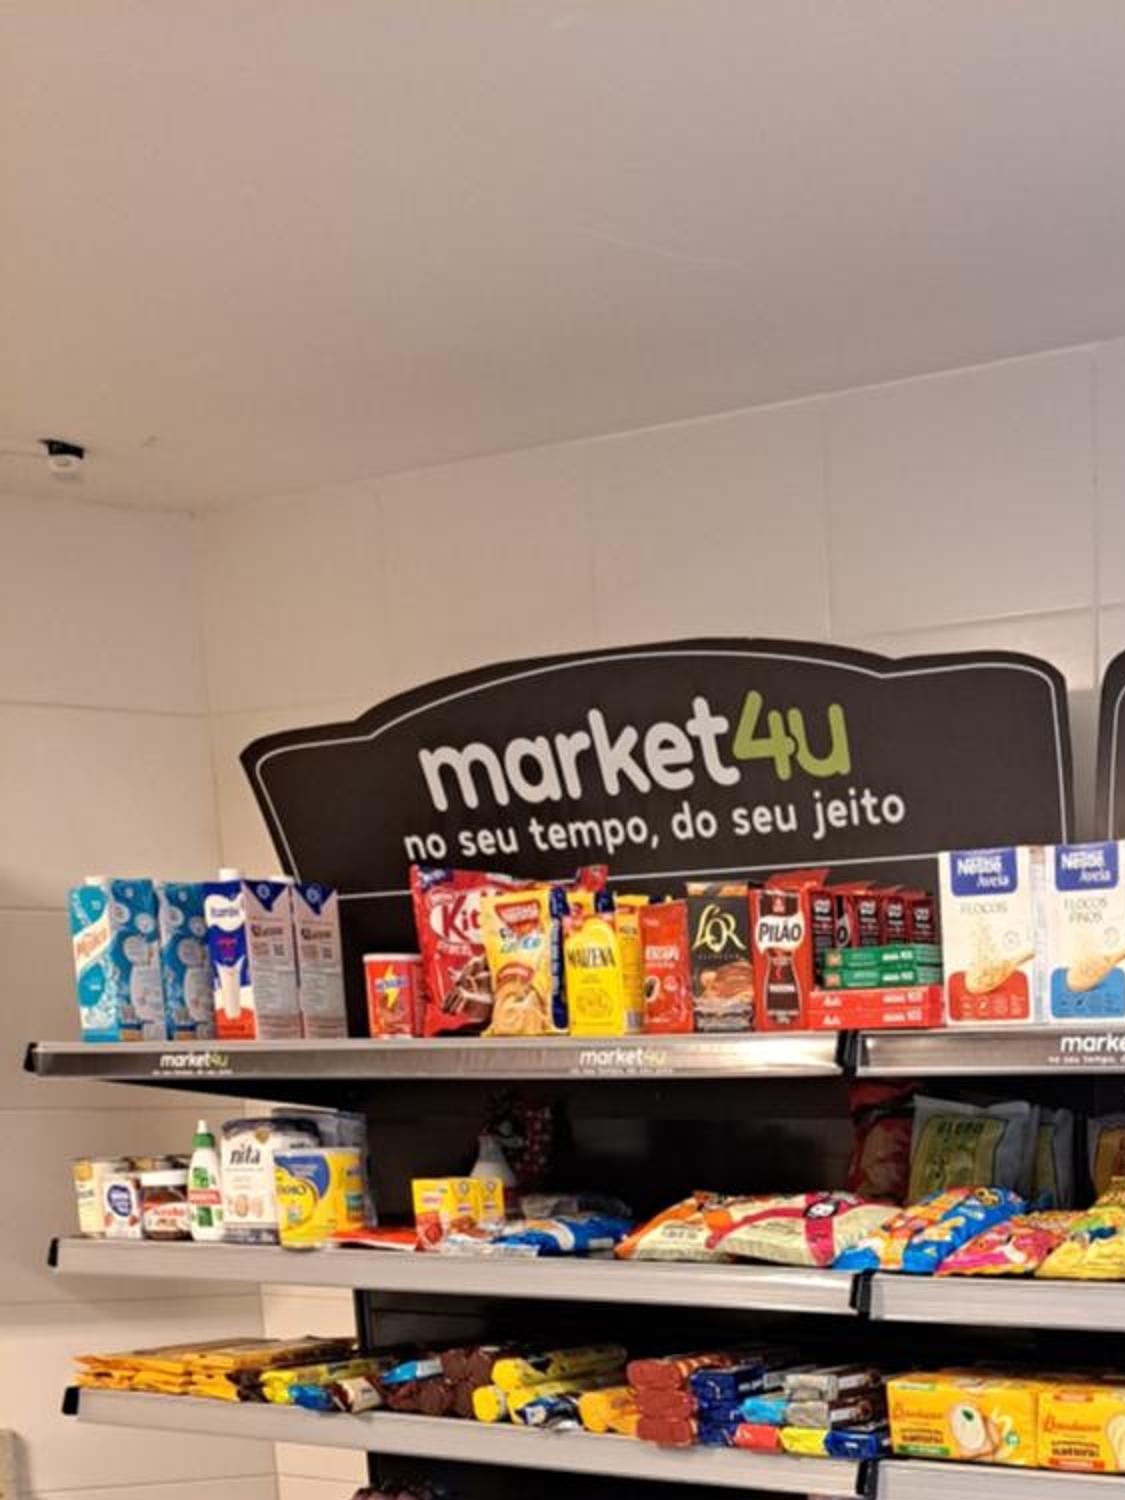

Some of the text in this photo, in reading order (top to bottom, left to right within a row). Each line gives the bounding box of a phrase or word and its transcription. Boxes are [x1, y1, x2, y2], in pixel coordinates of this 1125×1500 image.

[418, 690, 851, 812] market4u
[404, 787, 905, 860] no seu tempo, do seu jeito
